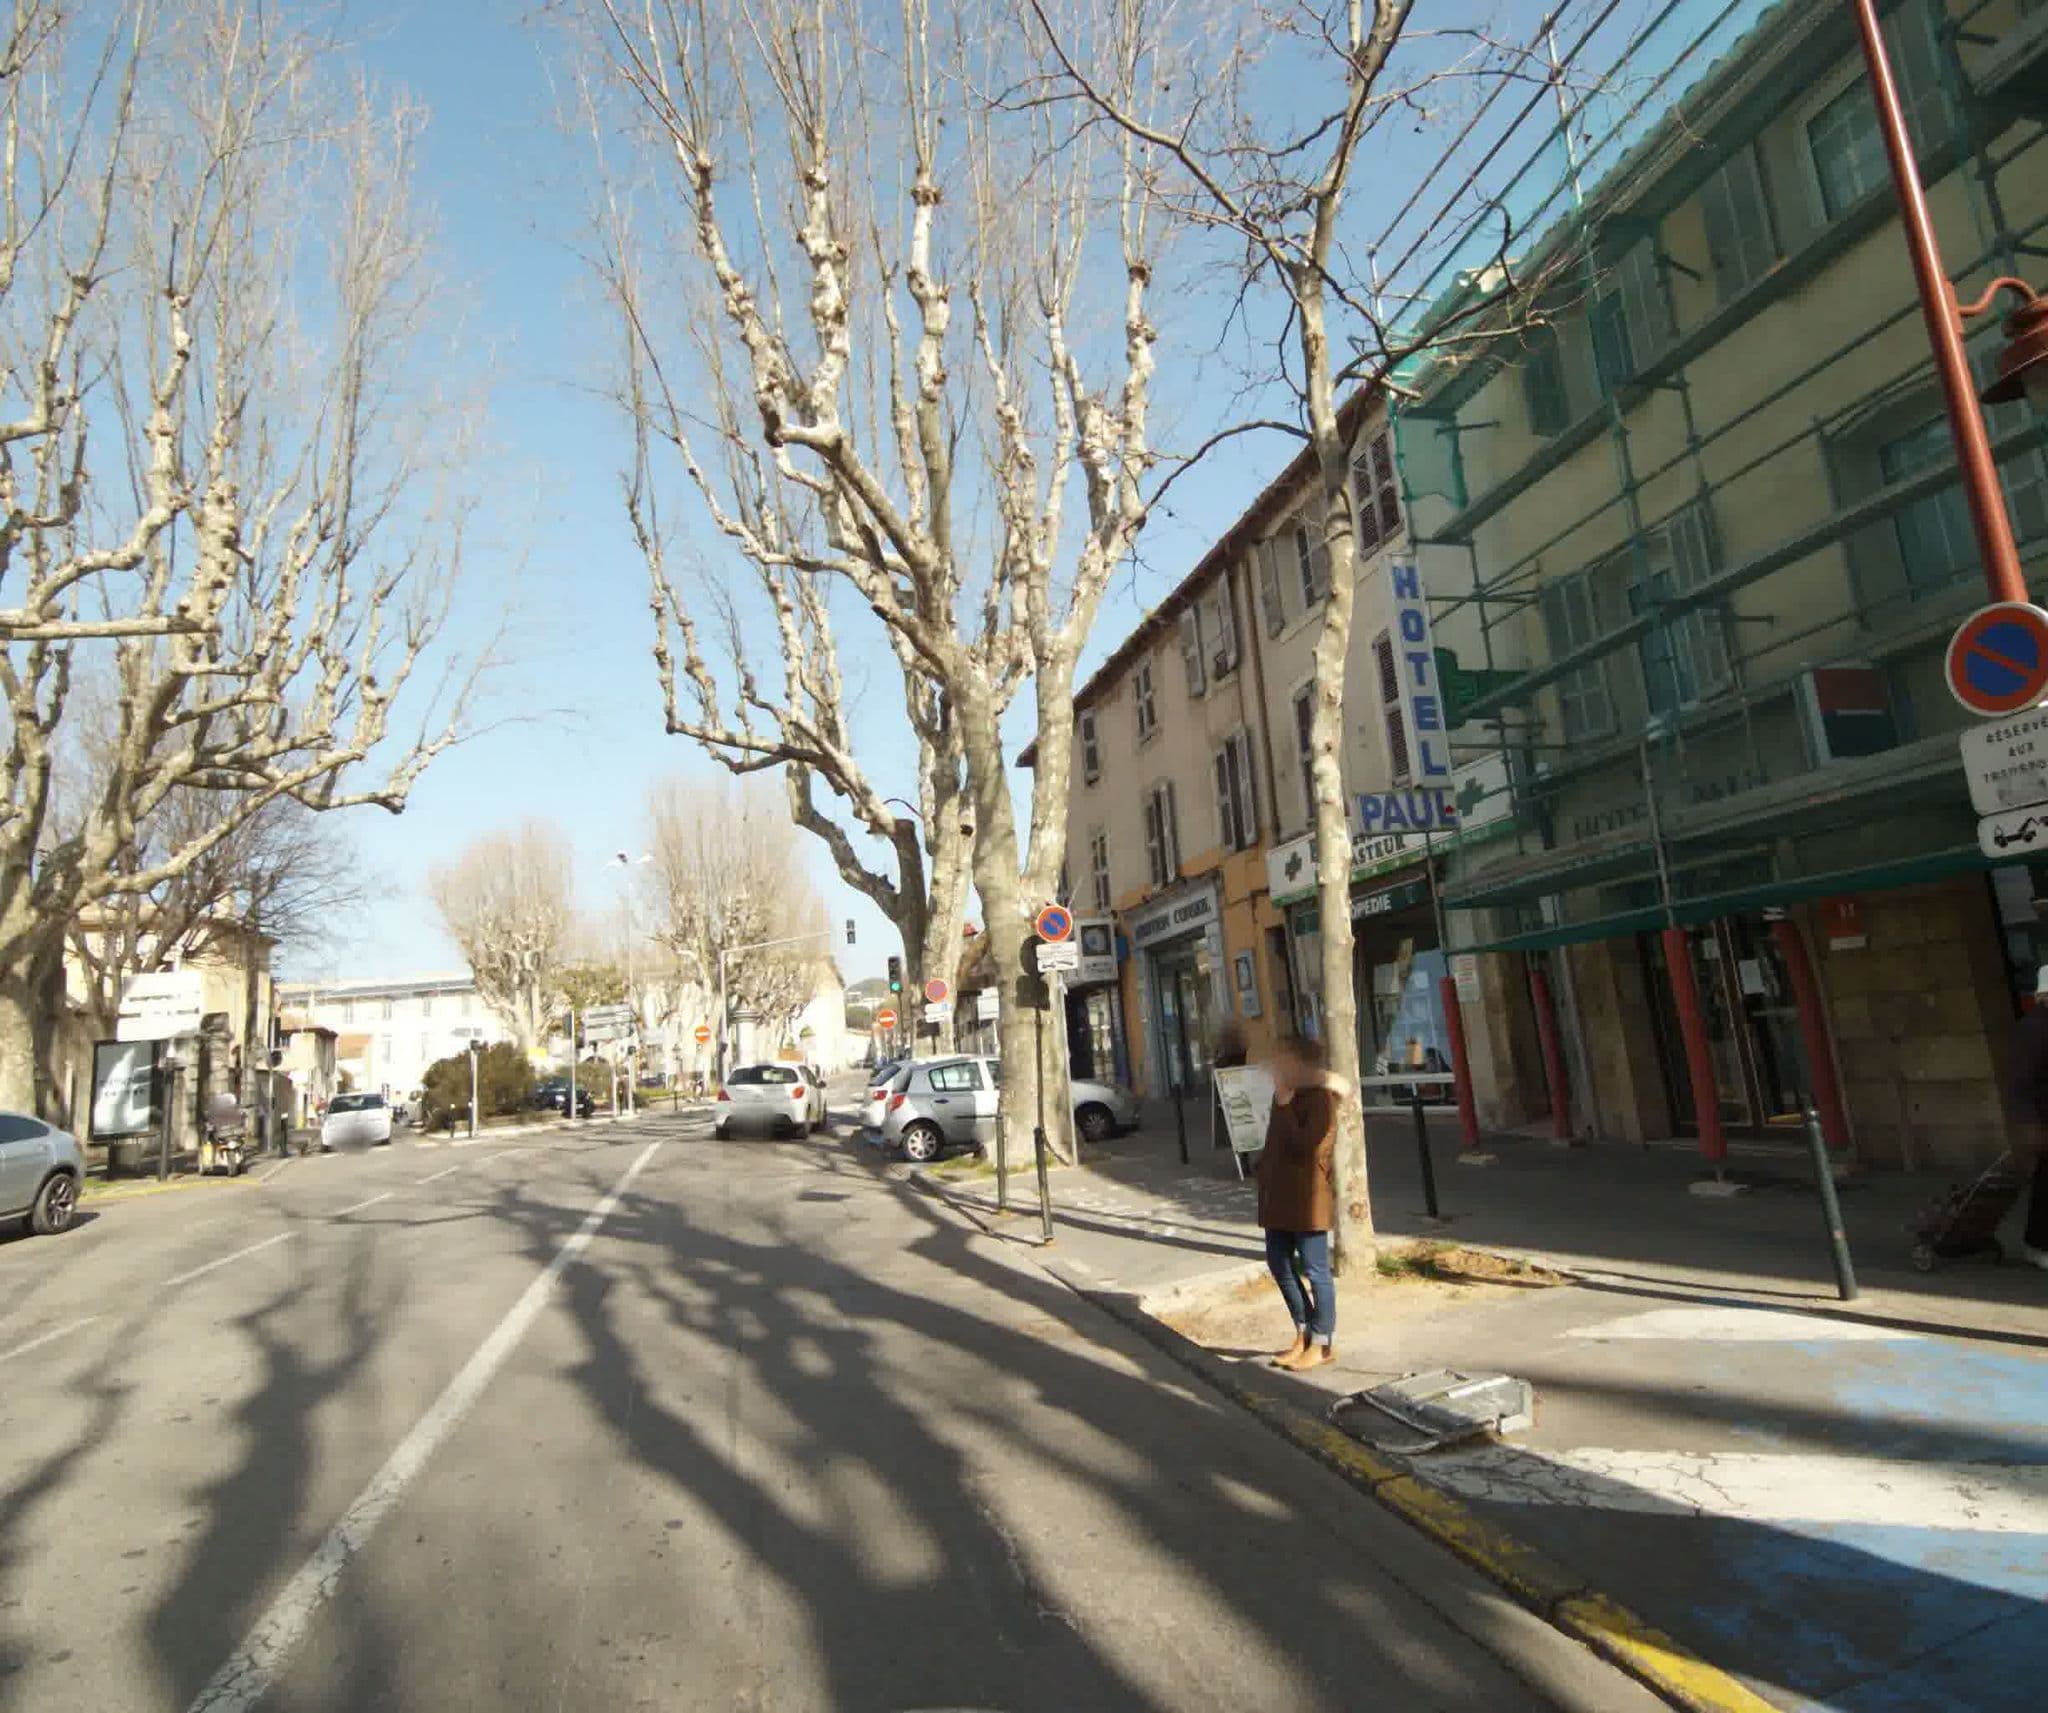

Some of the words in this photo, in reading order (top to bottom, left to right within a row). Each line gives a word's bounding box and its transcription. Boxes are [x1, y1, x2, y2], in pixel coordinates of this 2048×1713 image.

[1391, 565, 1447, 776] HOTEL
[1359, 790, 1458, 831] PAUL
[1350, 834, 1406, 866] ASTEUR
